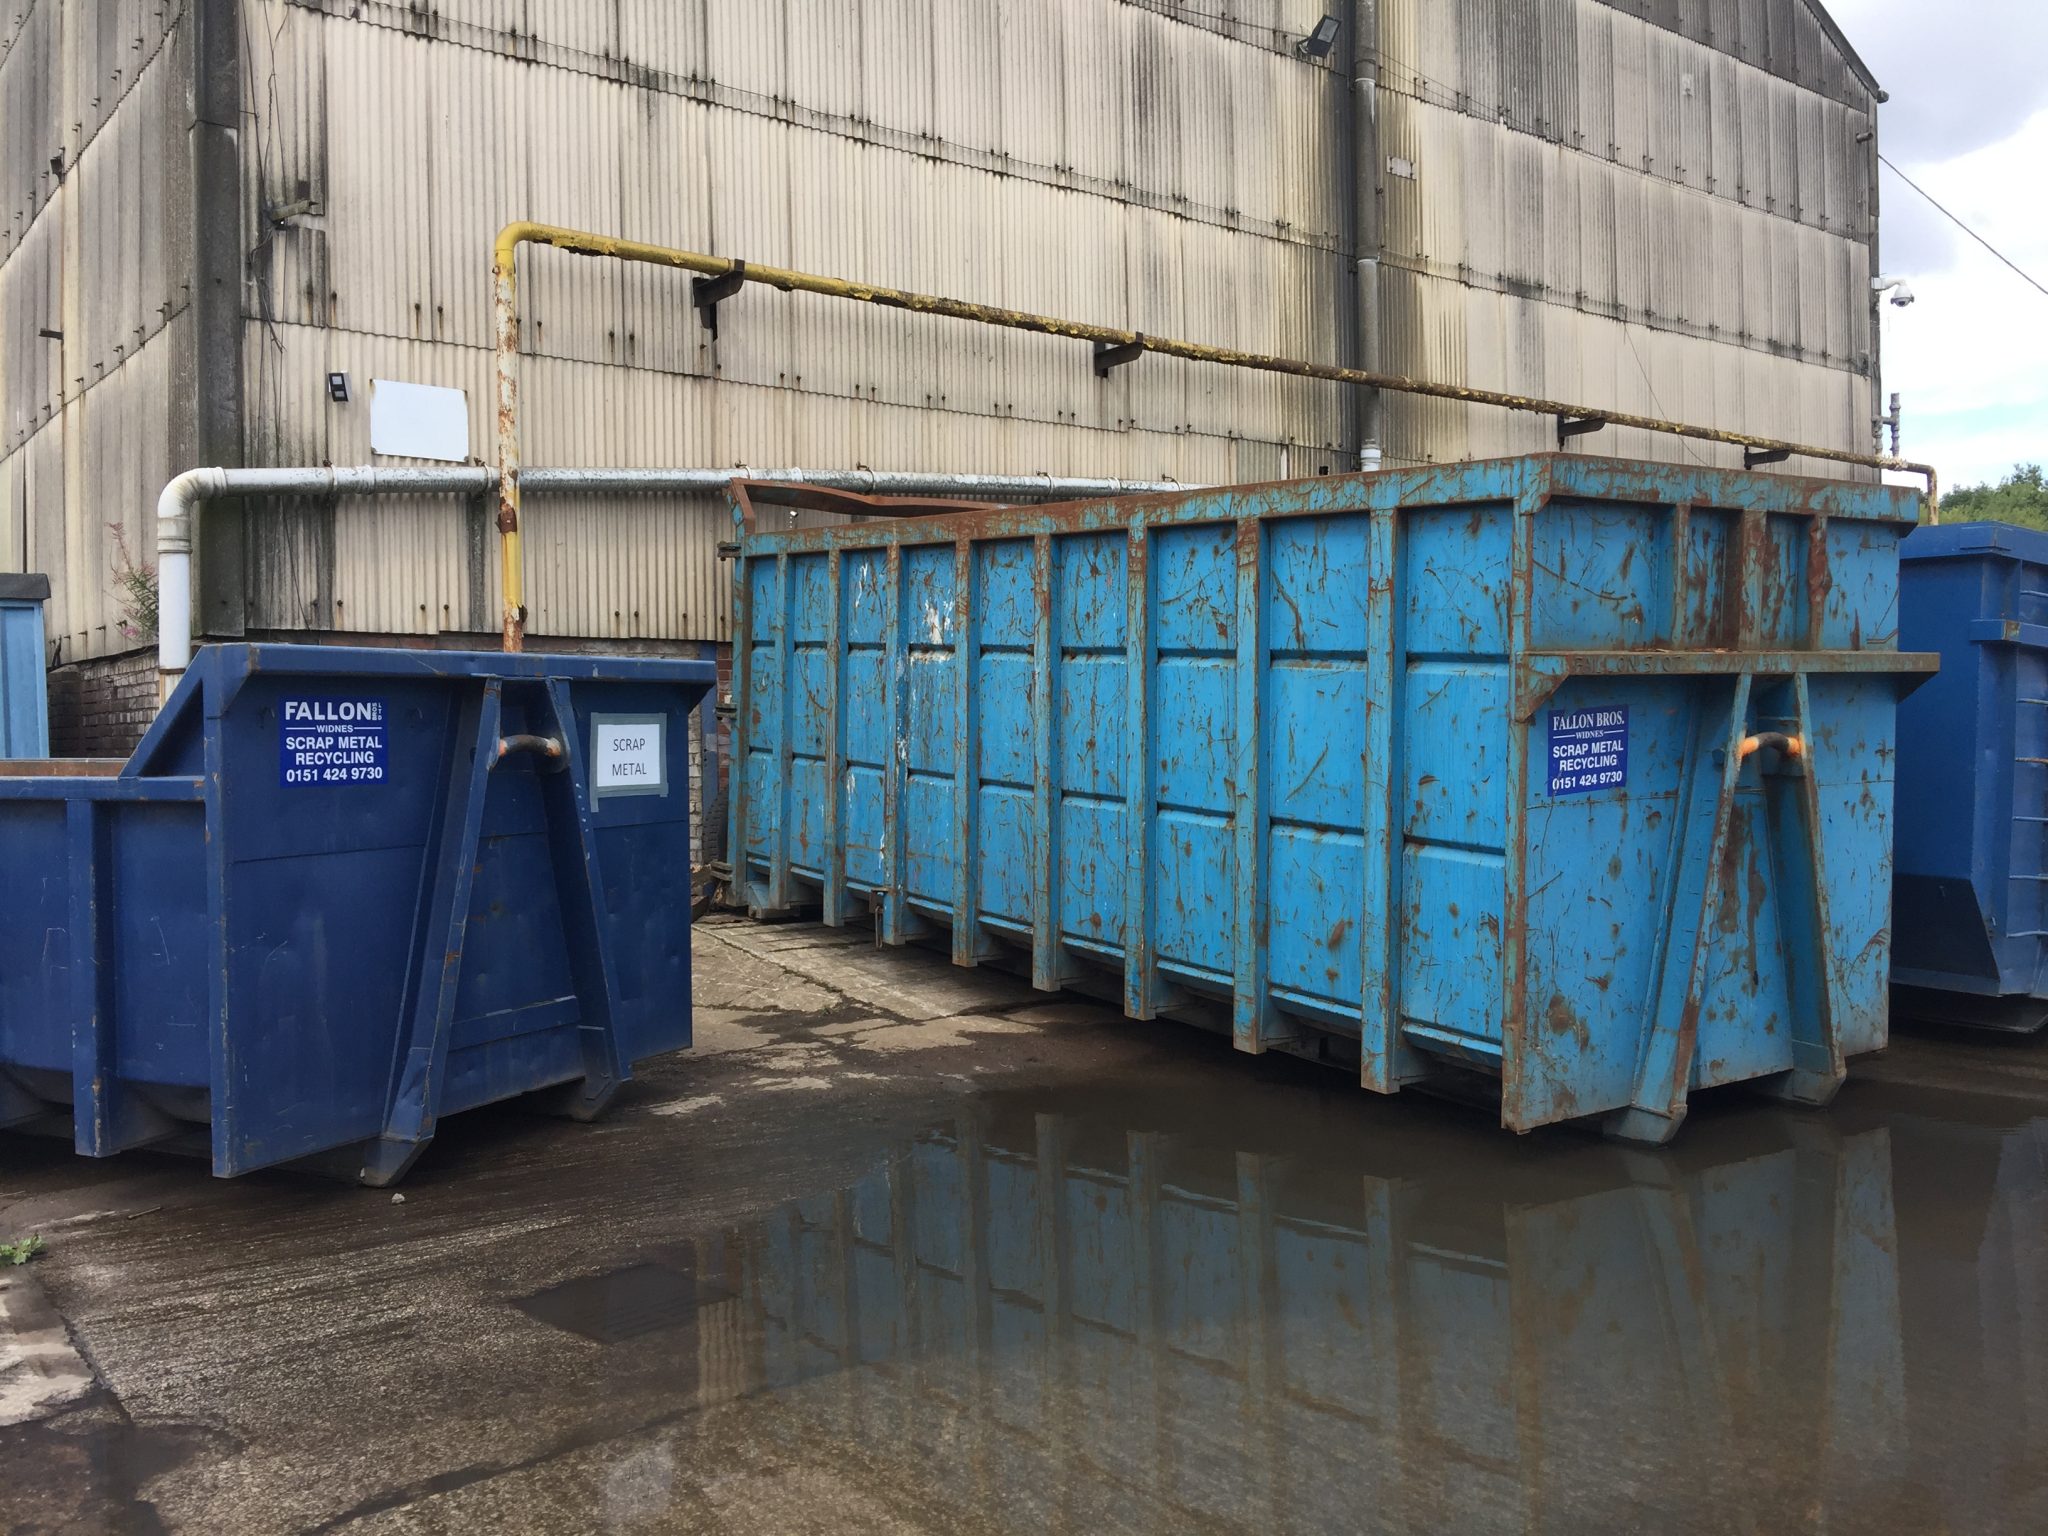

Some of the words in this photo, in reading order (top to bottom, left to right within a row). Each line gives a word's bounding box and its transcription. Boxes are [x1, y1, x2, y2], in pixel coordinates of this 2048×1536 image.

[285, 702, 371, 720] FALLON
[1553, 713, 1594, 731] FALLON
[1596, 711, 1624, 727] BROS.
[316, 725, 354, 733] WIDNES
[1575, 730, 1604, 739] WIDNES
[286, 737, 334, 750] SCRAP
[338, 736, 382, 749] METAL
[613, 738, 645, 752] SCRAP
[1553, 743, 1589, 758] SCRAP
[1591, 740, 1624, 754] METAL
[296, 751, 374, 765] RECYCLING
[1559, 754, 1617, 771] RECYCLING
[286, 769, 318, 782] 0151
[323, 768, 348, 781] 424
[351, 767, 383, 780] 9730
[612, 763, 647, 776] METAL
[1552, 776, 1576, 790] 0151
[1579, 774, 1597, 786] 424
[1599, 771, 1622, 784] 9730
